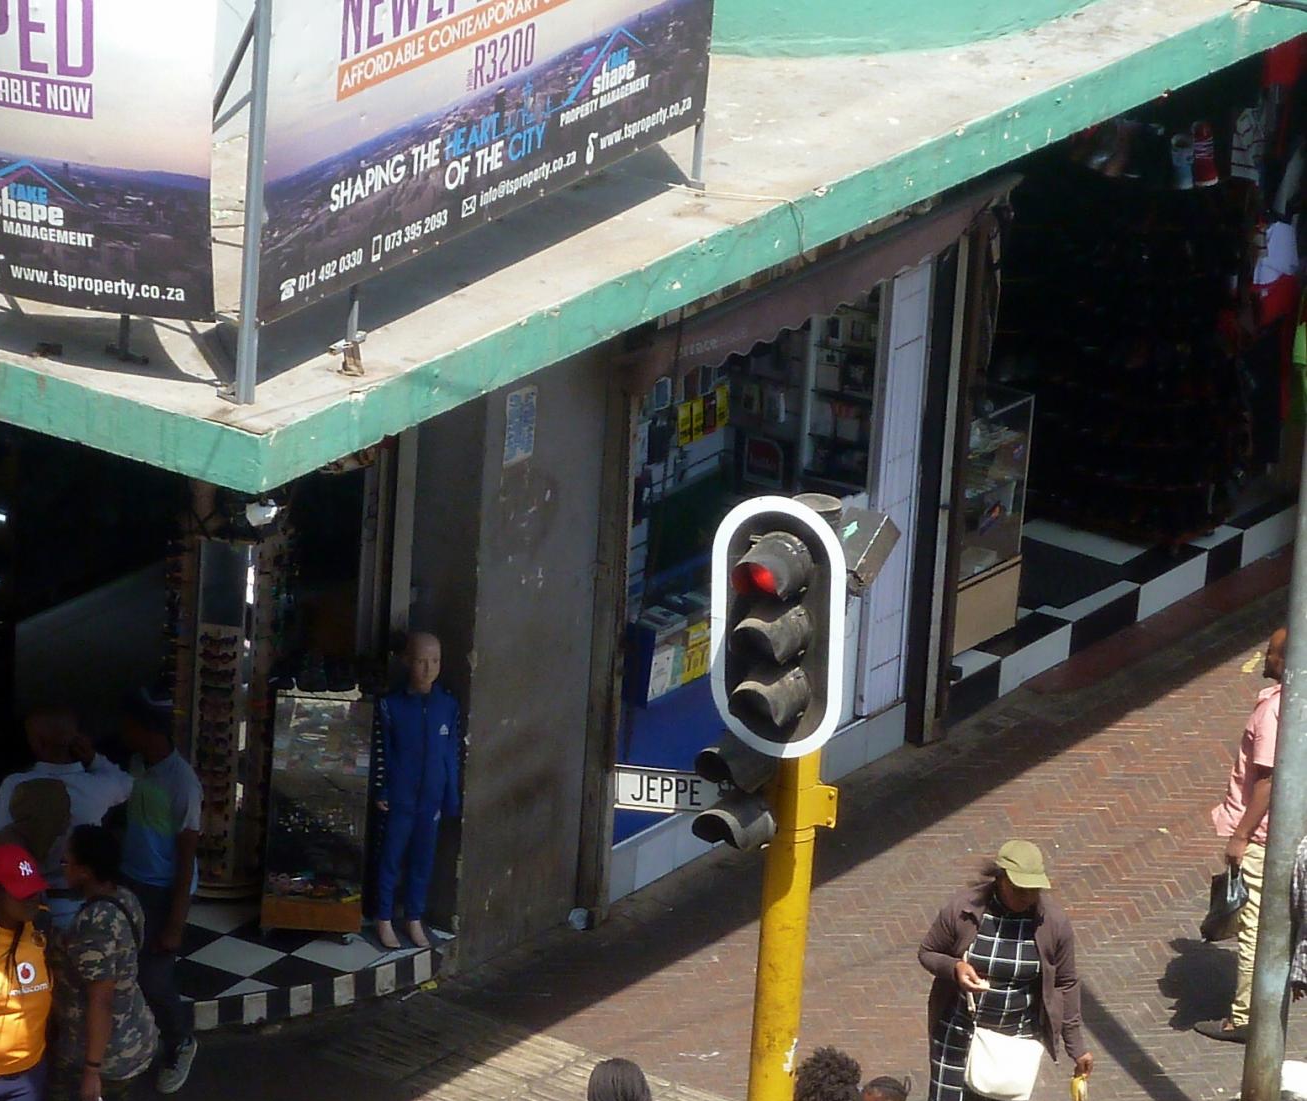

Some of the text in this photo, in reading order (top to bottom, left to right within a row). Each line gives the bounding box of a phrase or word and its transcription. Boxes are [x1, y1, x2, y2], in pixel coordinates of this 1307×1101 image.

[341, 36, 425, 92] AFFORDABLE
[474, 22, 536, 90] R3200
[592, 59, 636, 96] shape
[46, 84, 91, 114] NOW
[559, 74, 651, 127] PROPERTY MANAGEMENT
[599, 97, 692, 150] www.tsproperty.co.za
[329, 113, 500, 213] SHAPING THE HEART
[444, 121, 546, 191] OF THE CITY
[9, 183, 48, 206] TAKE
[479, 151, 577, 207] info@tsproperty.co.za
[3, 221, 94, 248] MANAGEMENT
[384, 209, 449, 253] 073 395 2093
[10, 264, 185, 302] www.tsproperty.co.za
[298, 248, 363, 292] 011 492 0330
[631, 774, 701, 806] JEPPE
